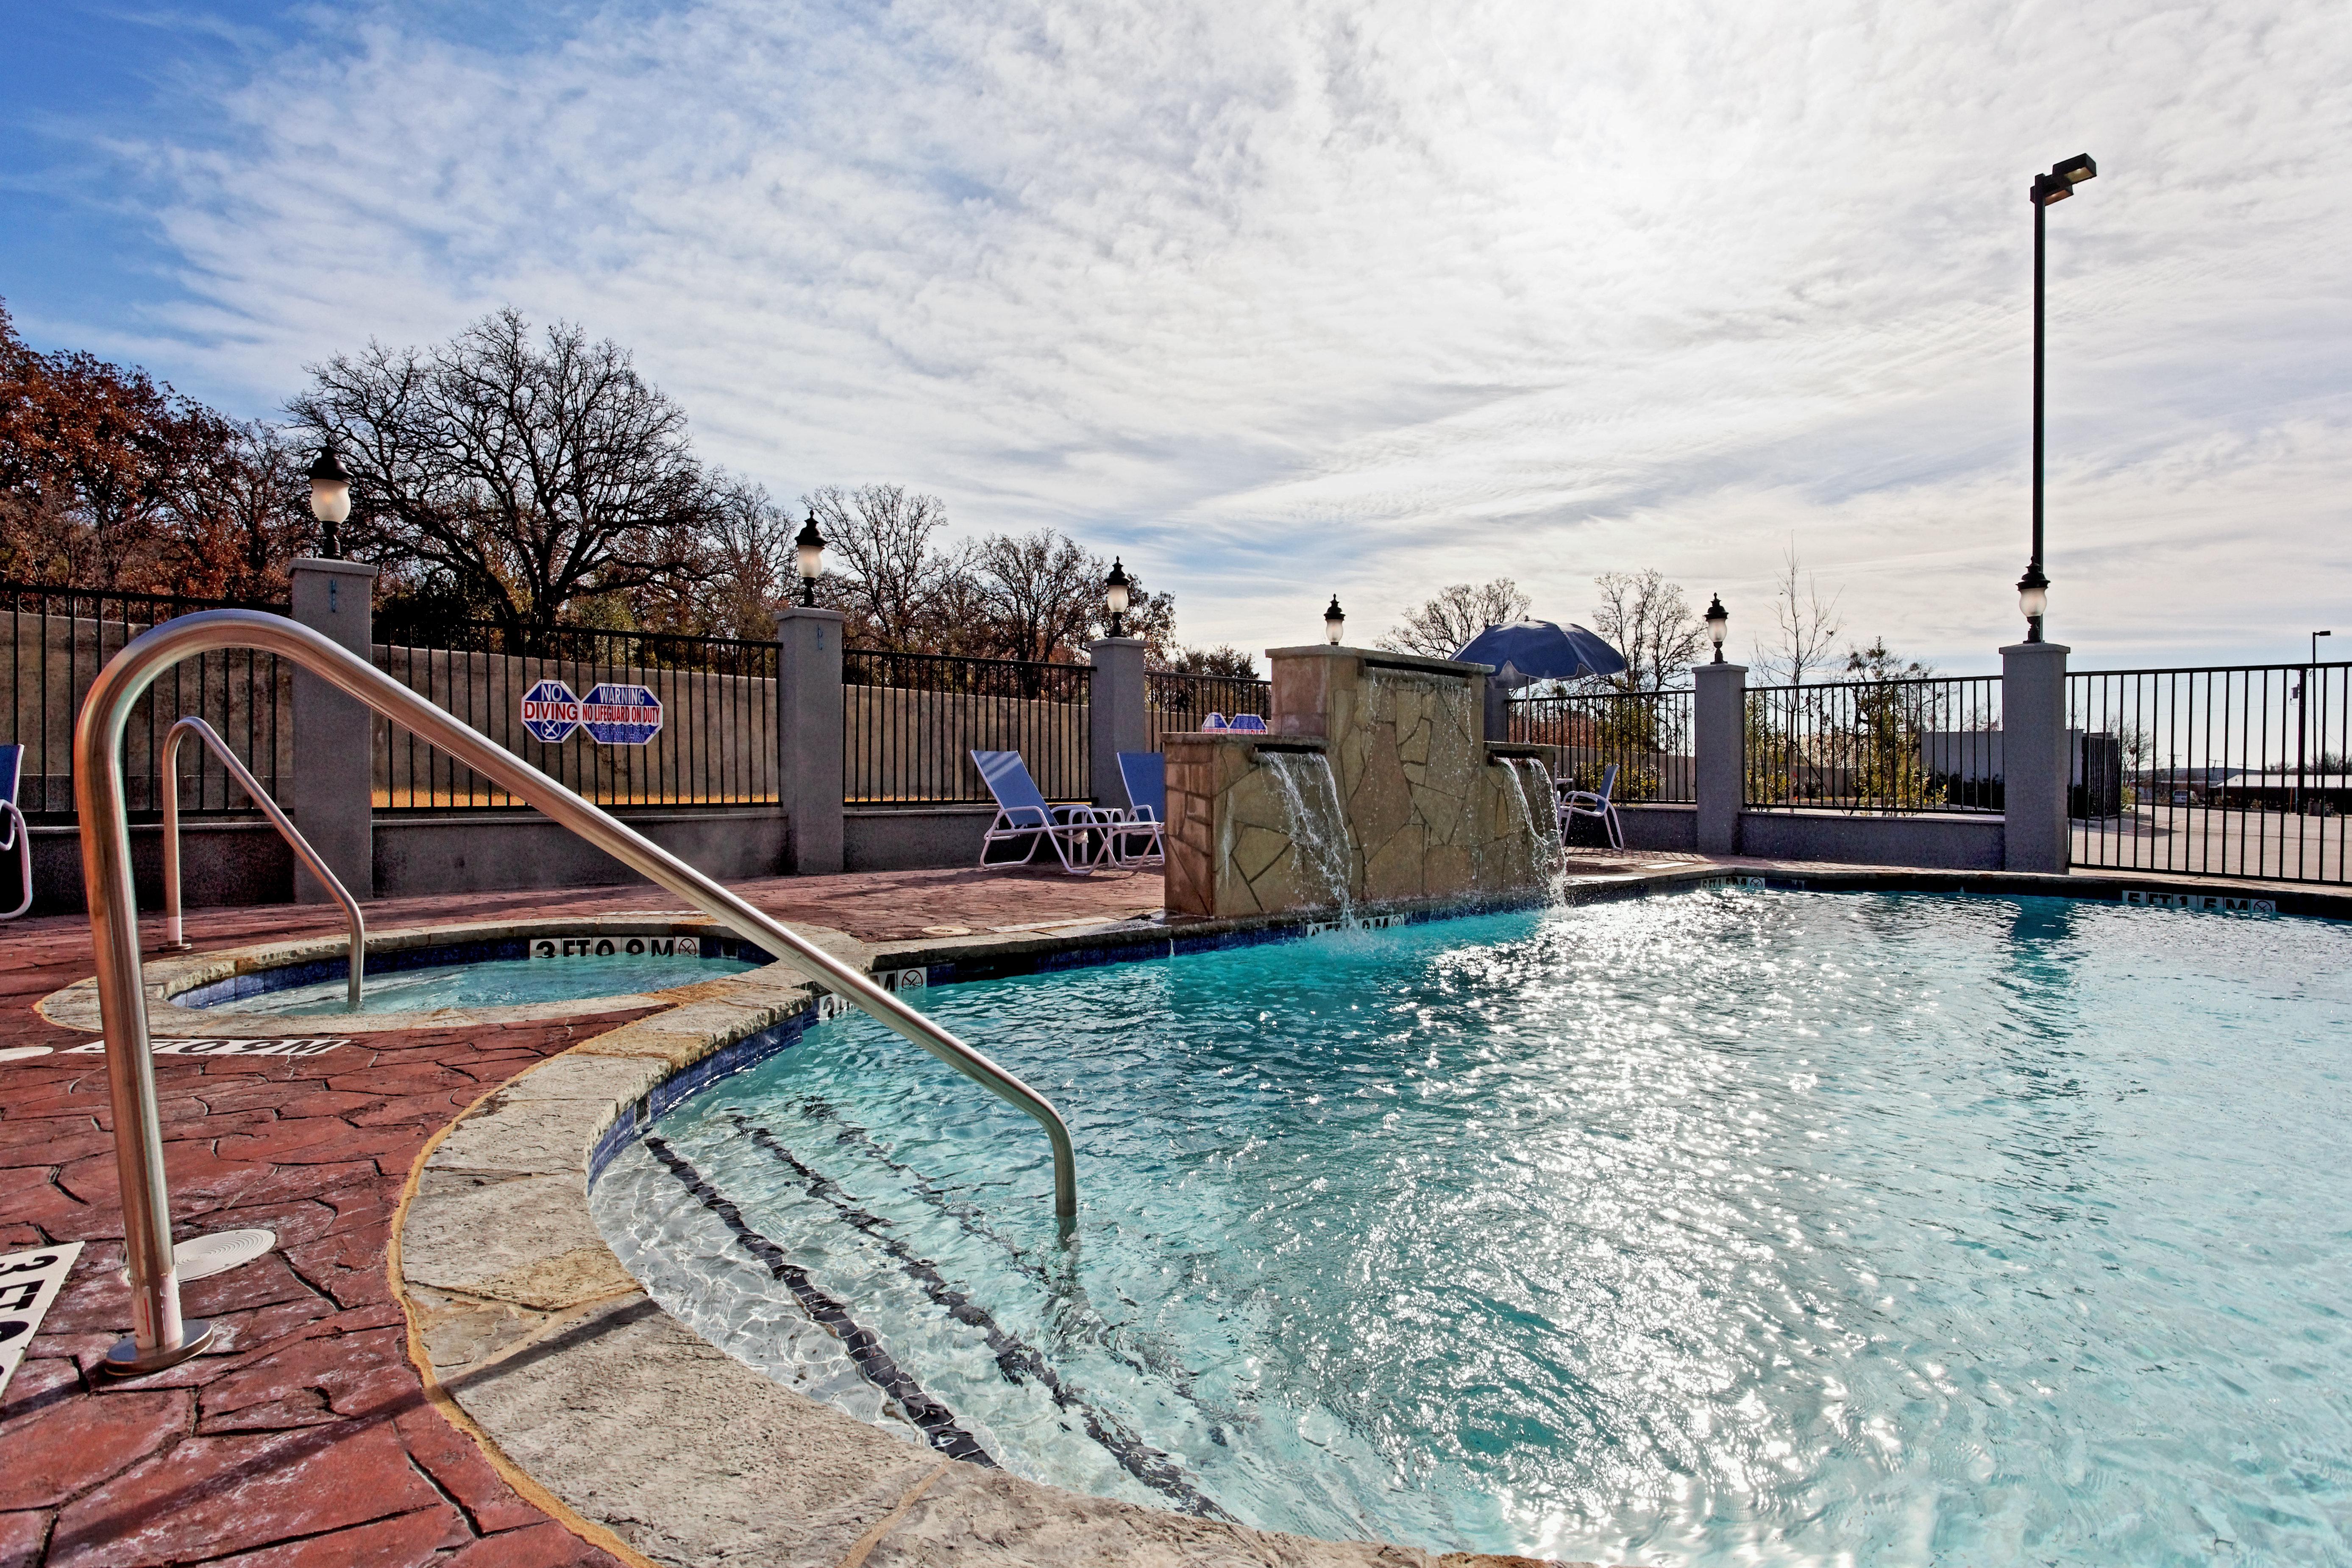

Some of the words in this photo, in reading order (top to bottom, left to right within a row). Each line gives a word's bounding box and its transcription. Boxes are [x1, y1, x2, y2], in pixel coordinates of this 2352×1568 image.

[541, 684, 562, 702] NO
[599, 687, 645, 705] WARNING
[525, 702, 578, 721] DIVING
[583, 705, 593, 721] NO
[595, 705, 630, 722] LIFEGUARD
[632, 706, 641, 723] ON
[643, 707, 660, 723] DUTY
[592, 724, 610, 733] CHILDREN
[610, 725, 624, 734] SHOULD
[641, 726, 650, 735] POOL
[599, 733, 613, 742] WITHOUT
[614, 733, 624, 742] ADULT
[624, 733, 645, 742] SUPERVISION
